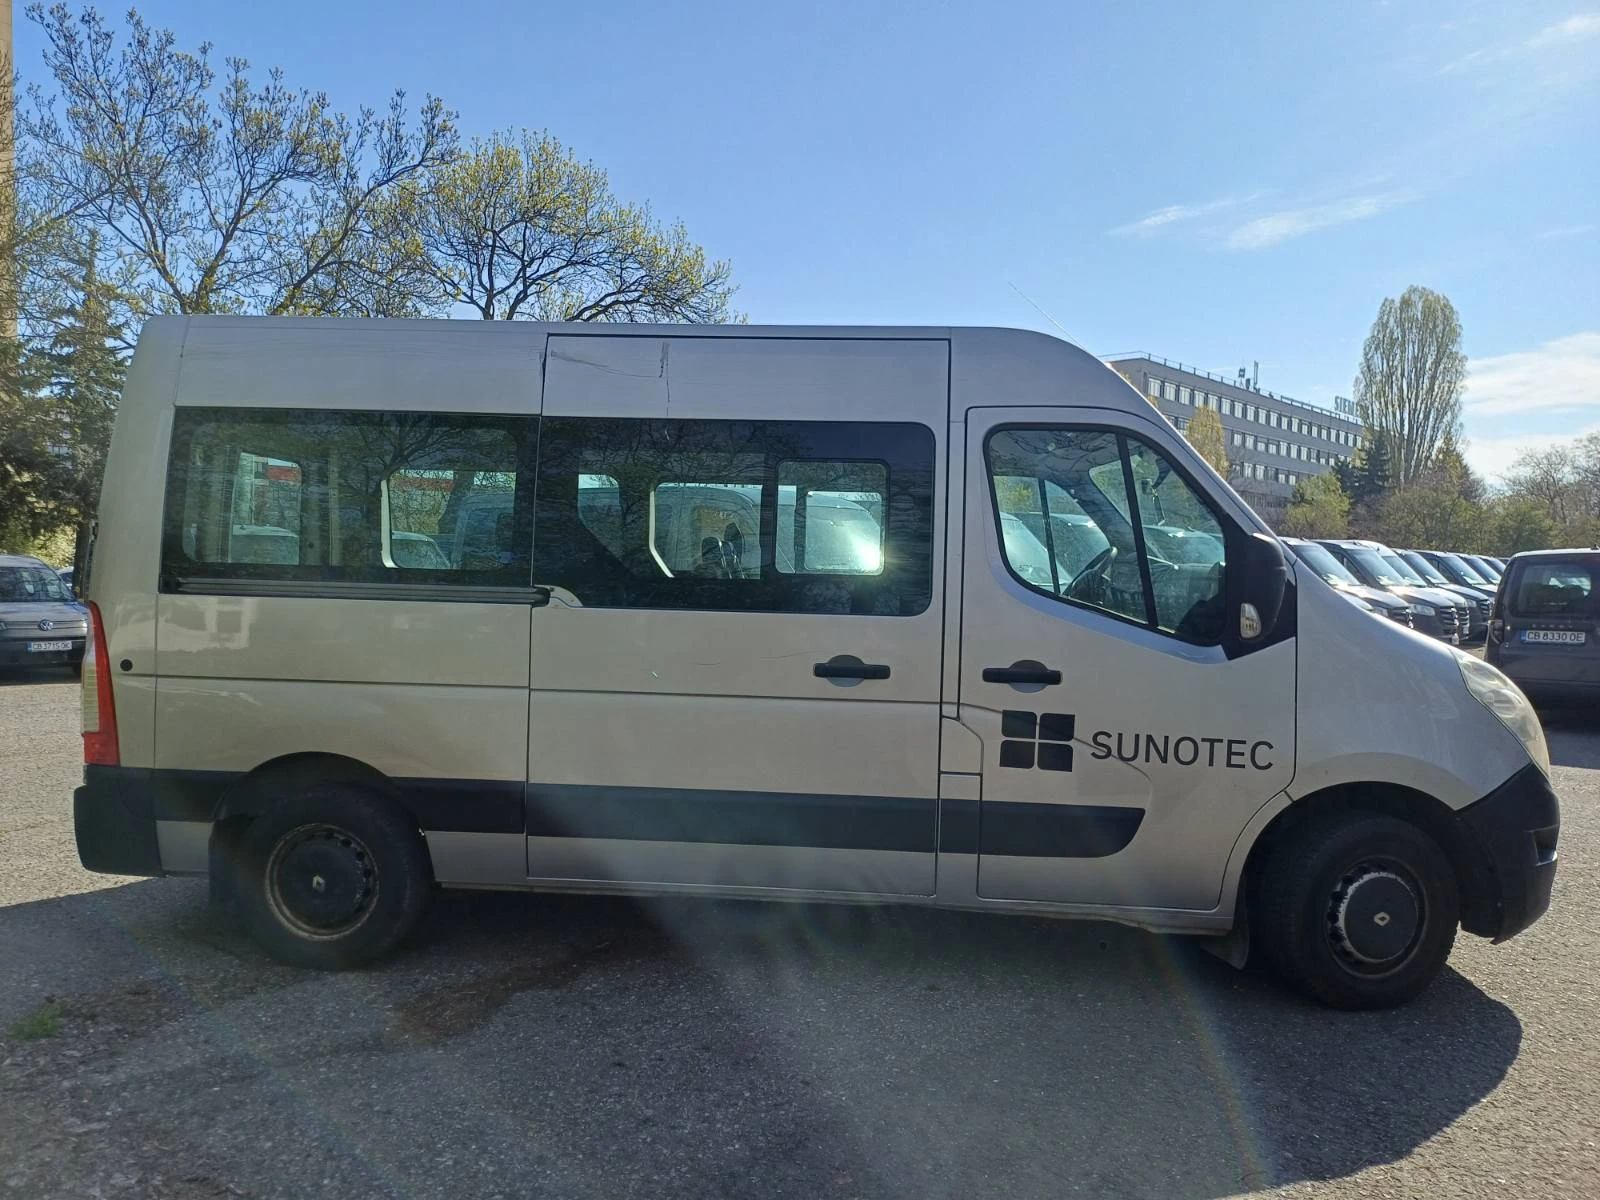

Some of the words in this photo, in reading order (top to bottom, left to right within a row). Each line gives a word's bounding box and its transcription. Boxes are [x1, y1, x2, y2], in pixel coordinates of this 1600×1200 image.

[1527, 631, 1540, 641] CB
[1542, 631, 1568, 641] 8330
[1090, 730, 1274, 771] SUNOTEC
